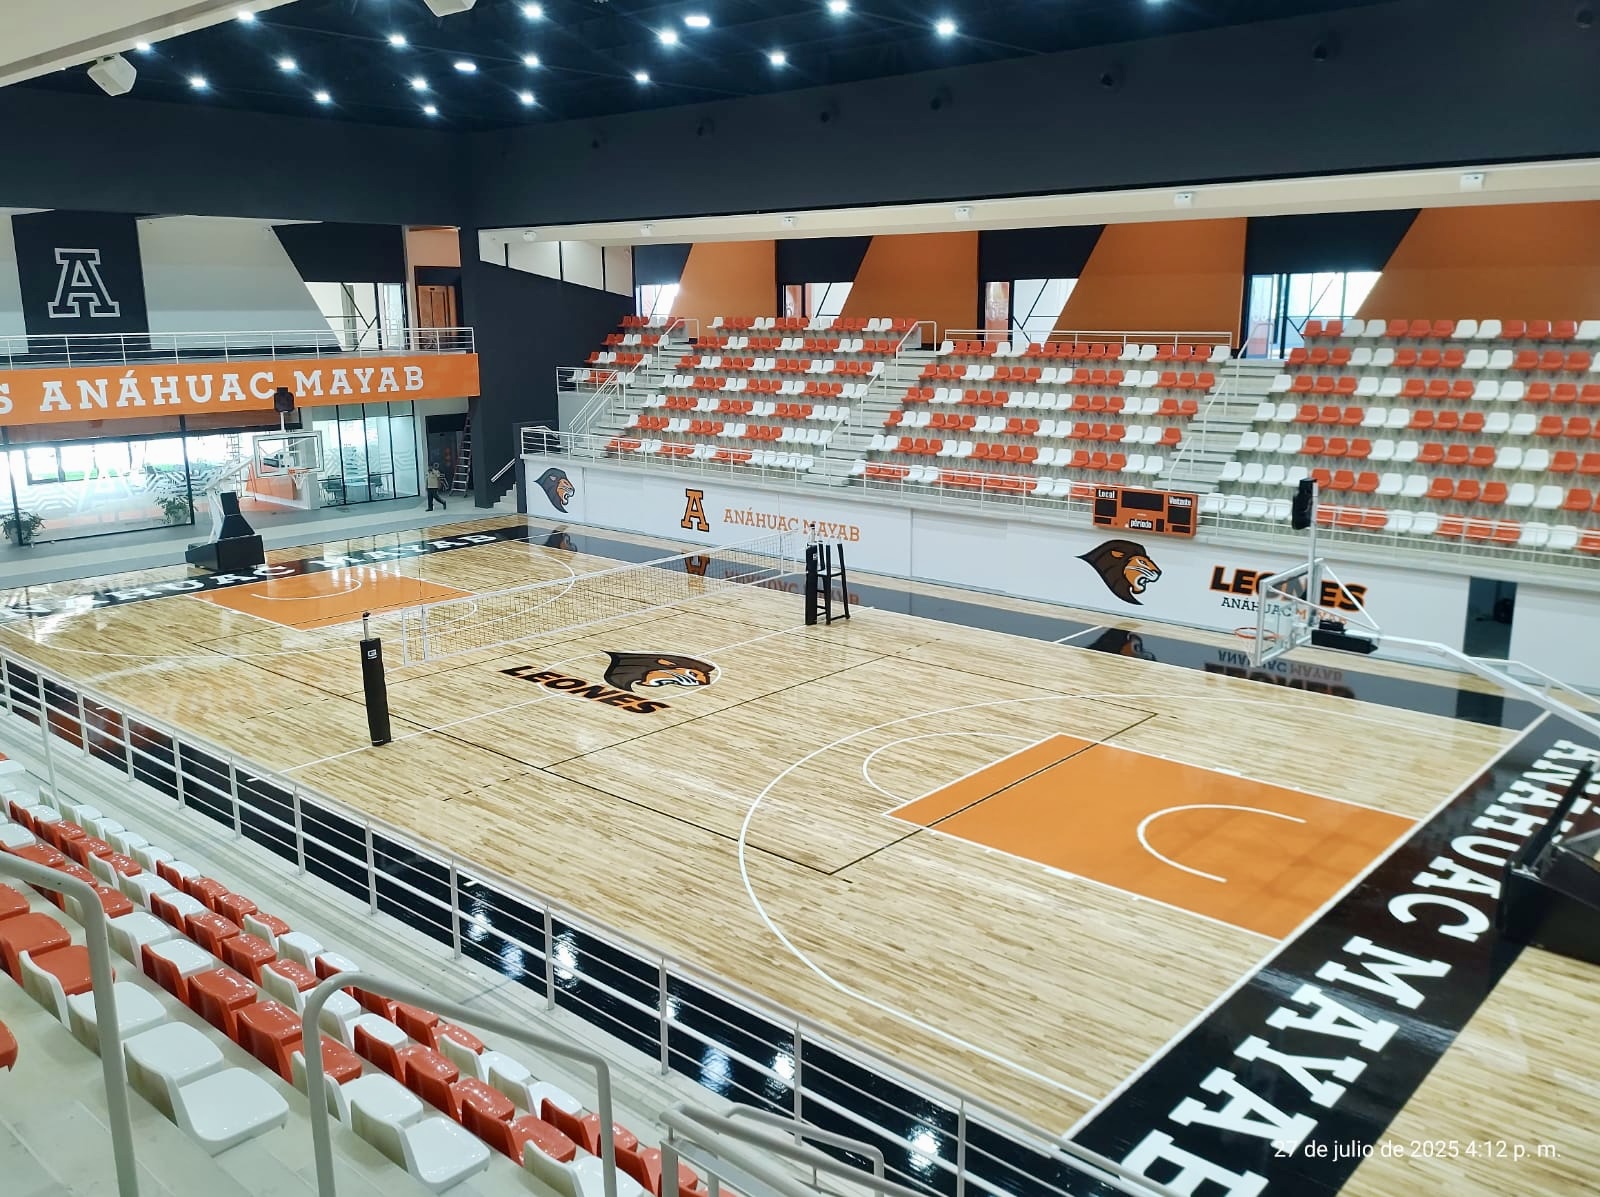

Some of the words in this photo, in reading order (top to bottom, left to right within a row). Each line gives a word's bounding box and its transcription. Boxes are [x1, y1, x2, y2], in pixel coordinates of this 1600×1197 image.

[48, 248, 120, 318] A
[40, 370, 276, 412] ANÁHUAC
[293, 366, 425, 397] MAYAB
[681, 488, 709, 532] A
[1098, 489, 1115, 499] Local
[723, 507, 799, 531] ANÁHUAC
[497, 665, 671, 714] LEONES
